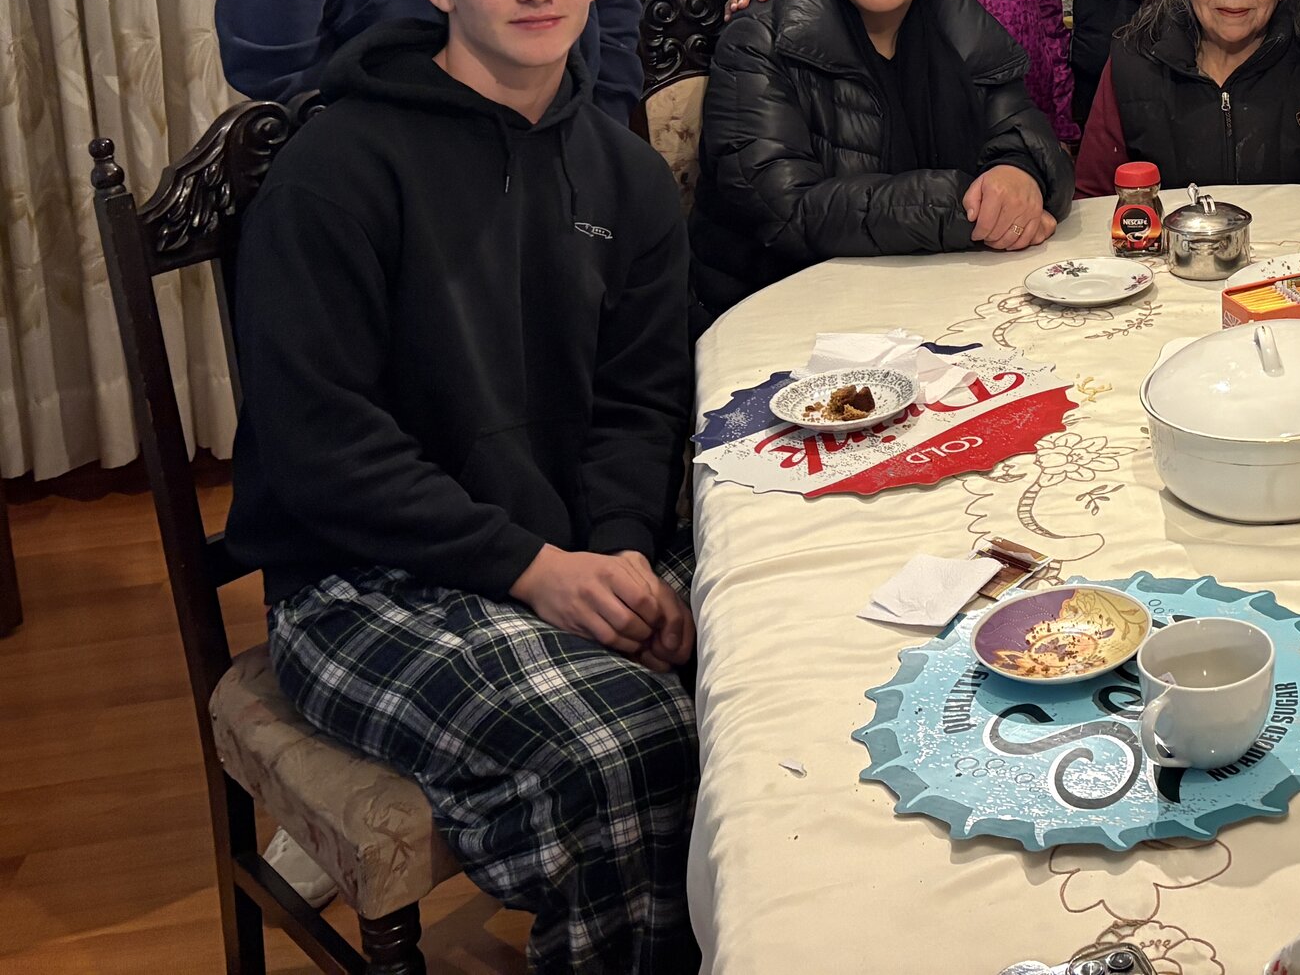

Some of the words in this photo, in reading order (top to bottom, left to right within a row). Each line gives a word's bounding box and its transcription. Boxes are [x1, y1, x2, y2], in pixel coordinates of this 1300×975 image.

[905, 435, 984, 464] COLD
[942, 670, 990, 735] QUALITY
[1238, 724, 1288, 768] ADDED
[1270, 681, 1299, 725] SUGAR
